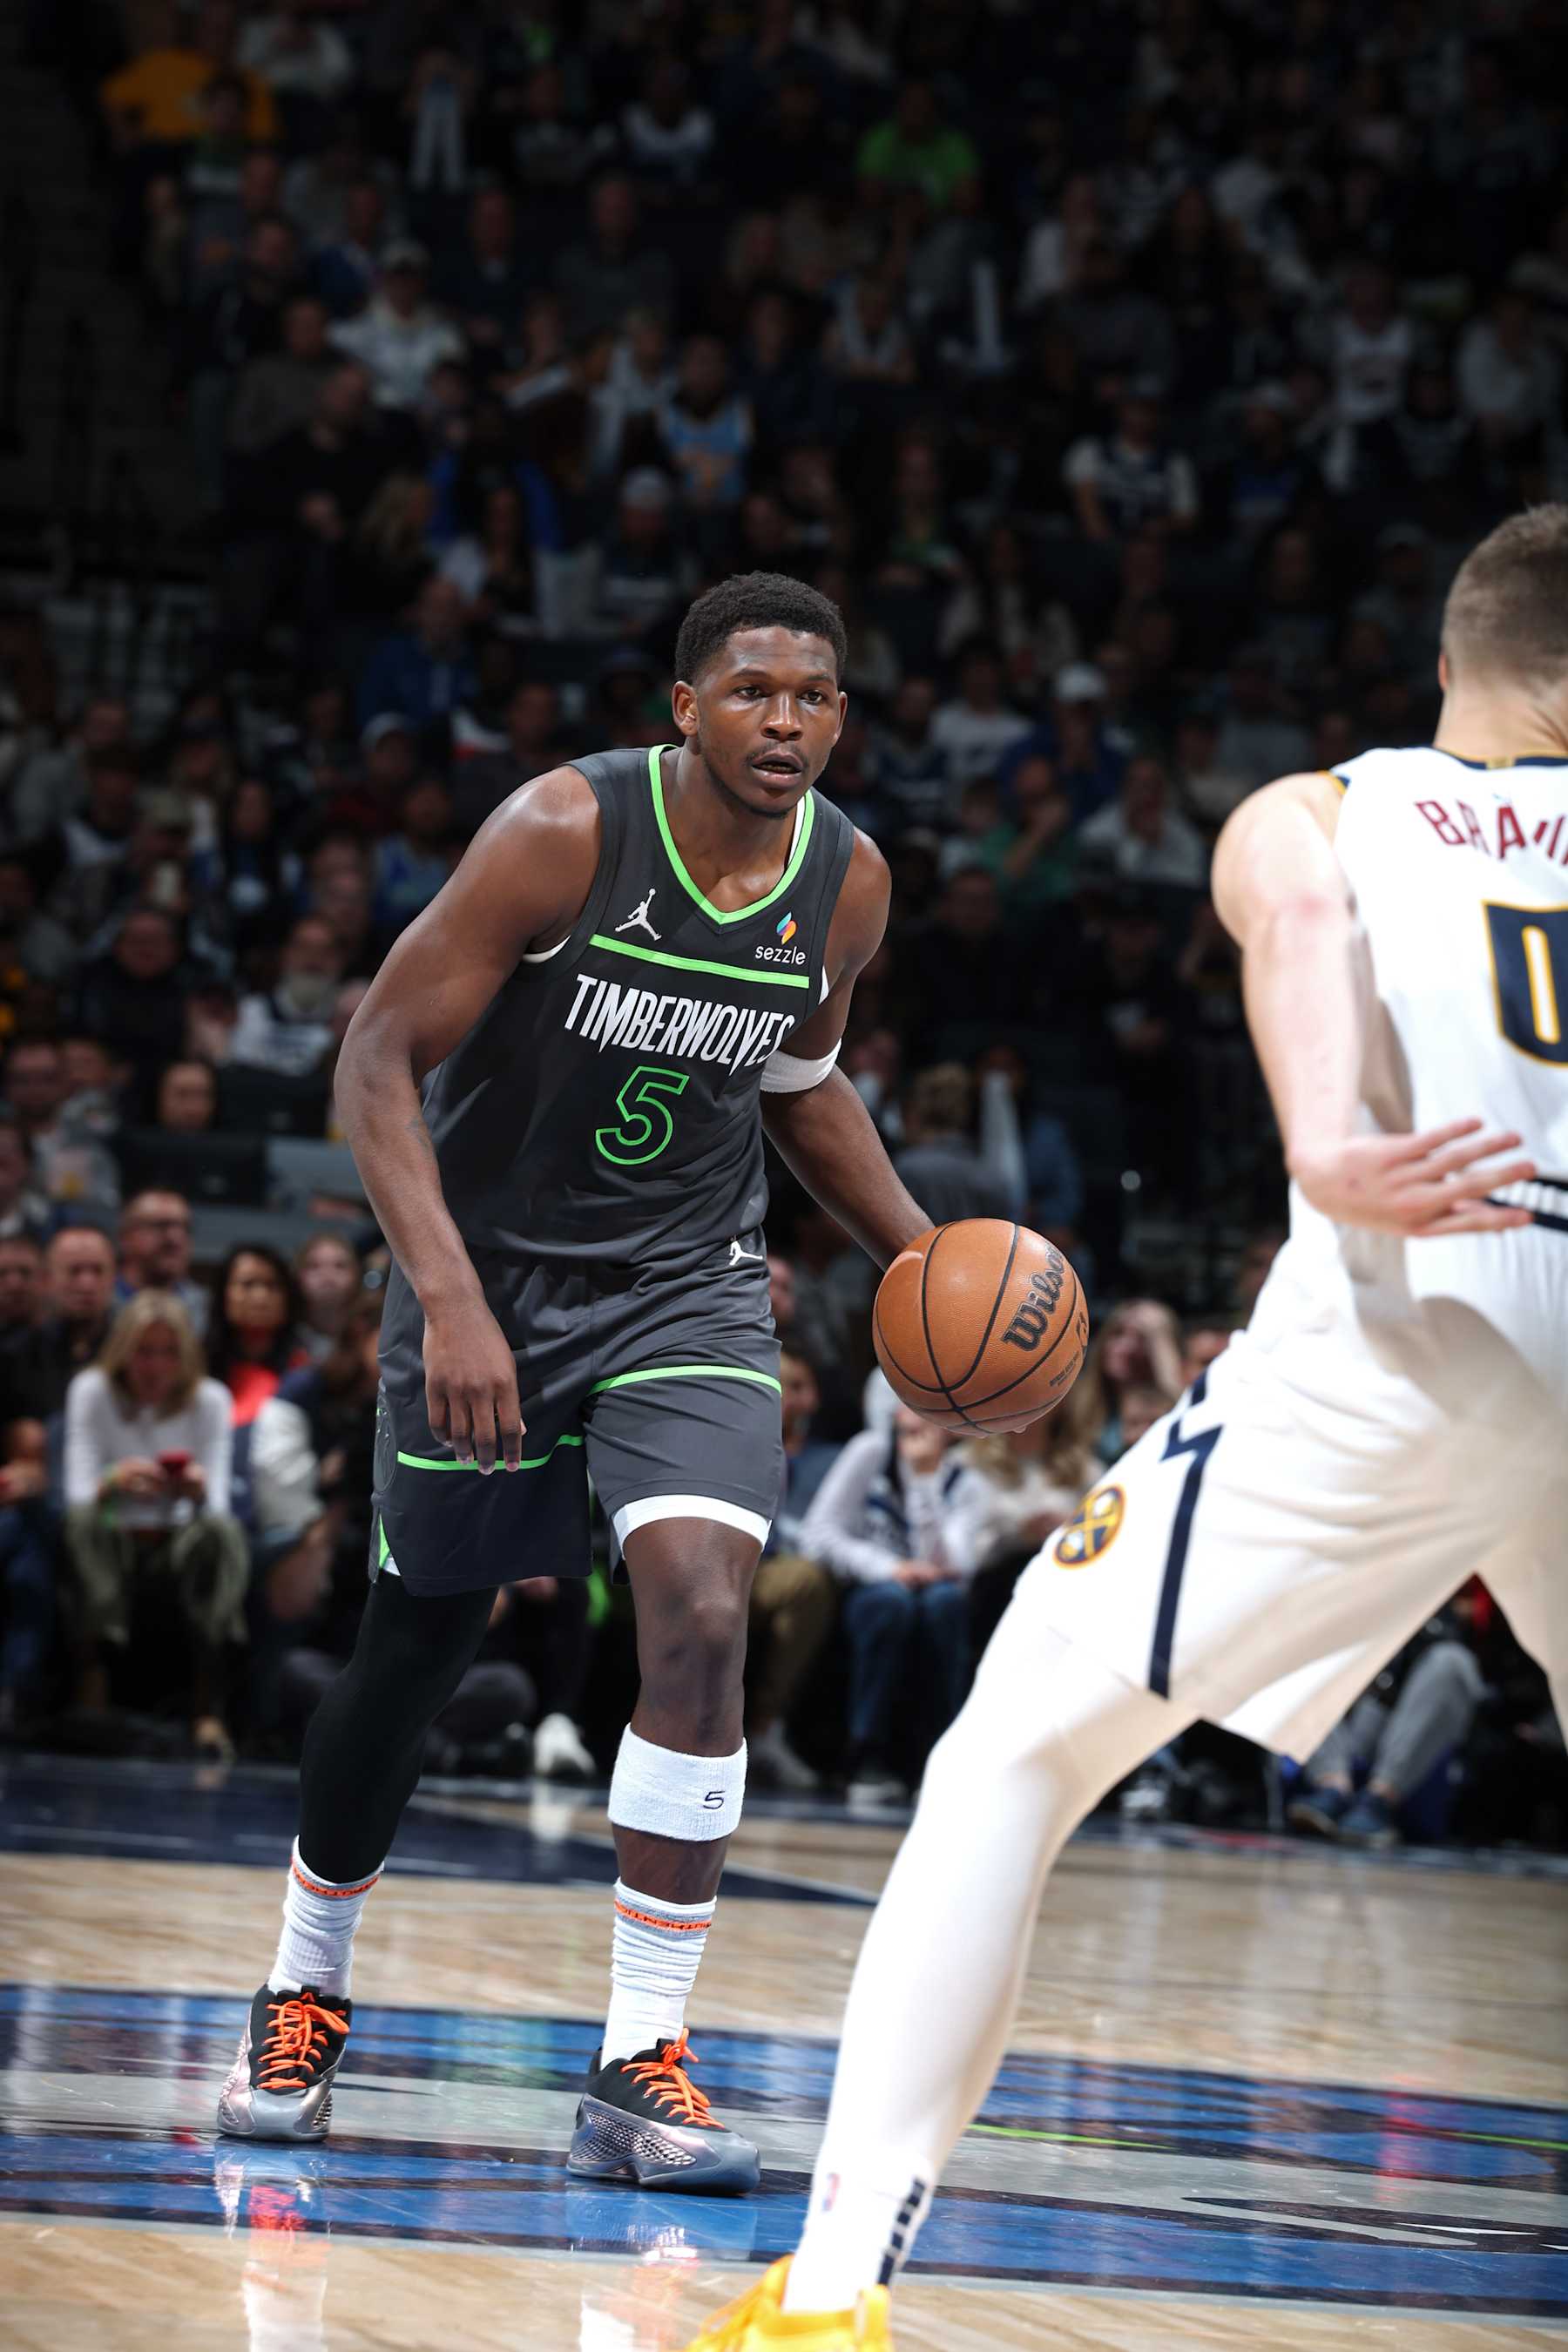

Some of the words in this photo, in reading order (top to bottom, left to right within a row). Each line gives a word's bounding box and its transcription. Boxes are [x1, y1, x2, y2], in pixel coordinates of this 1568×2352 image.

[755, 945, 806, 965] sezzle
[564, 974, 794, 1076] TIMBERWOLVES
[596, 1066, 689, 1165] 5
[703, 1790, 725, 1809] 5
